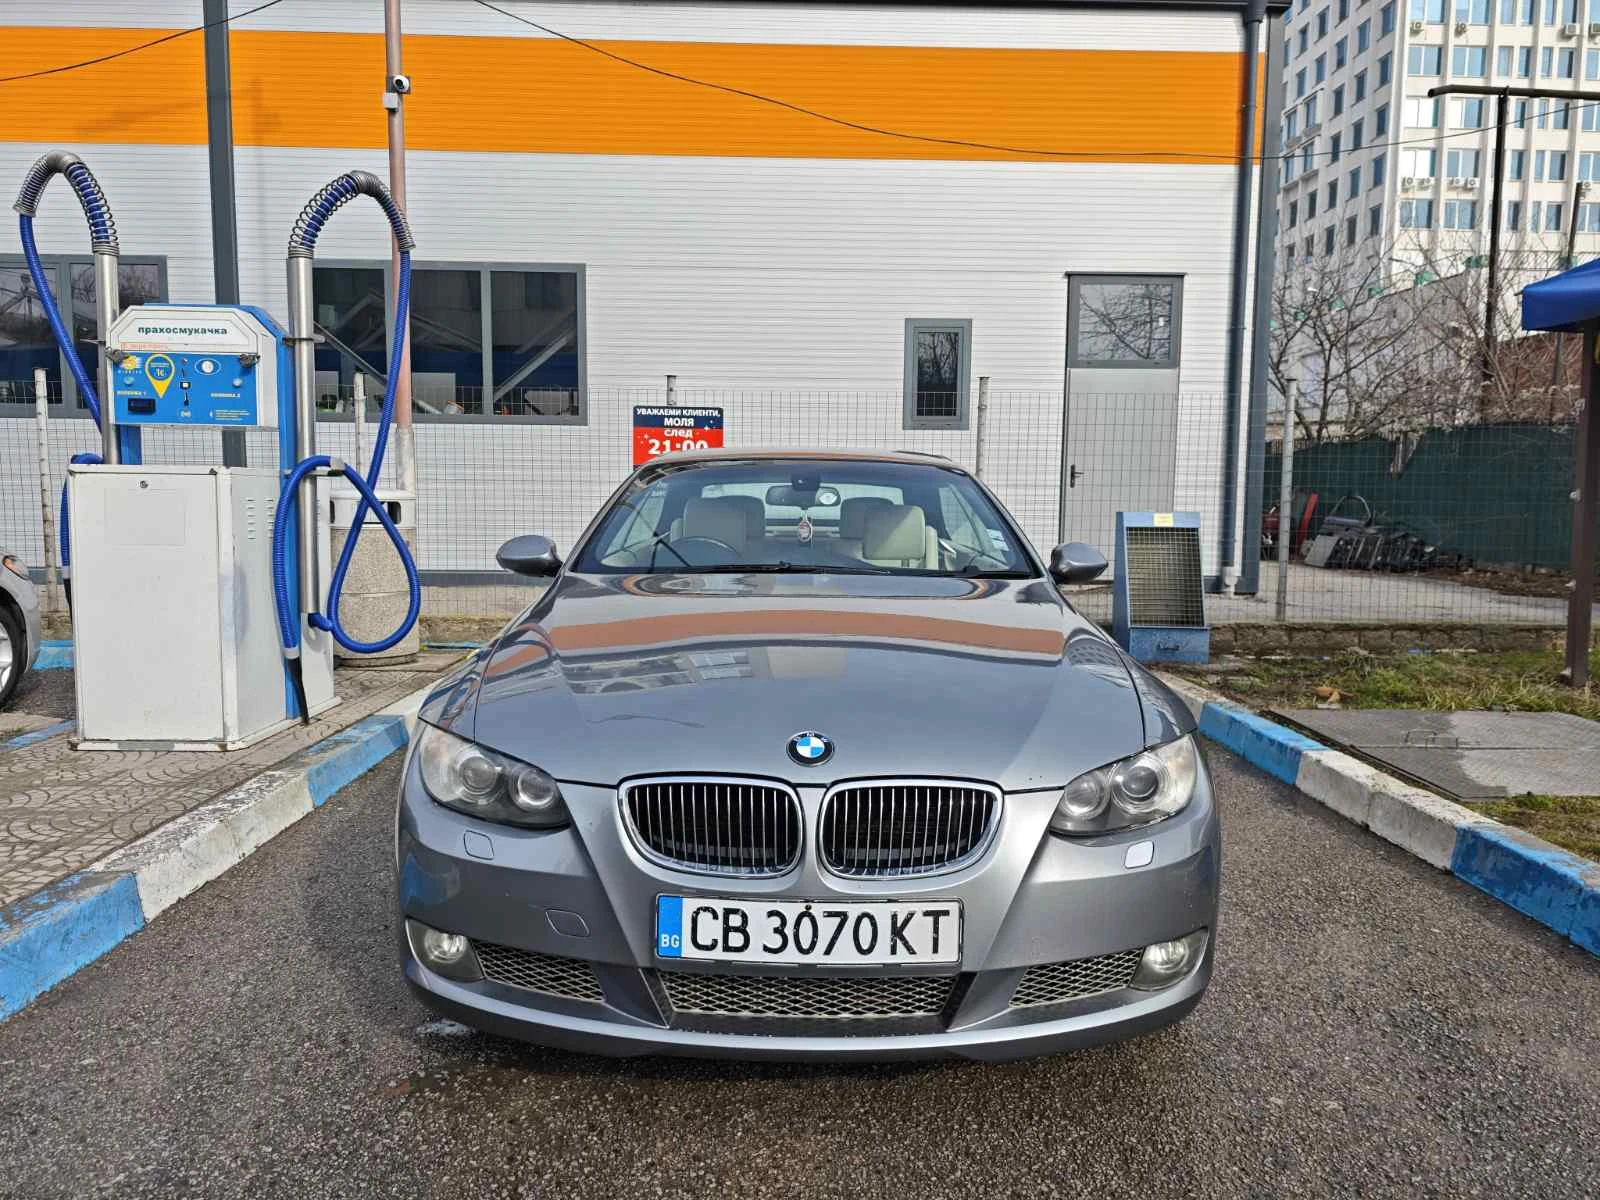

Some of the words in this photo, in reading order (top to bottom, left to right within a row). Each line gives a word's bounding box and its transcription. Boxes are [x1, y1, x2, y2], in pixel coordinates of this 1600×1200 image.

[138, 326, 228, 337] прахосмукачка
[636, 408, 682, 416] УВАЖАЕМИ
[682, 409, 721, 417] КЛИЕНТИ,
[664, 418, 695, 427] МОЛЯ
[664, 428, 693, 438] след
[690, 906, 751, 953] CB
[762, 909, 878, 956] 3070
[890, 910, 951, 956] KT
[661, 933, 680, 948] BG
